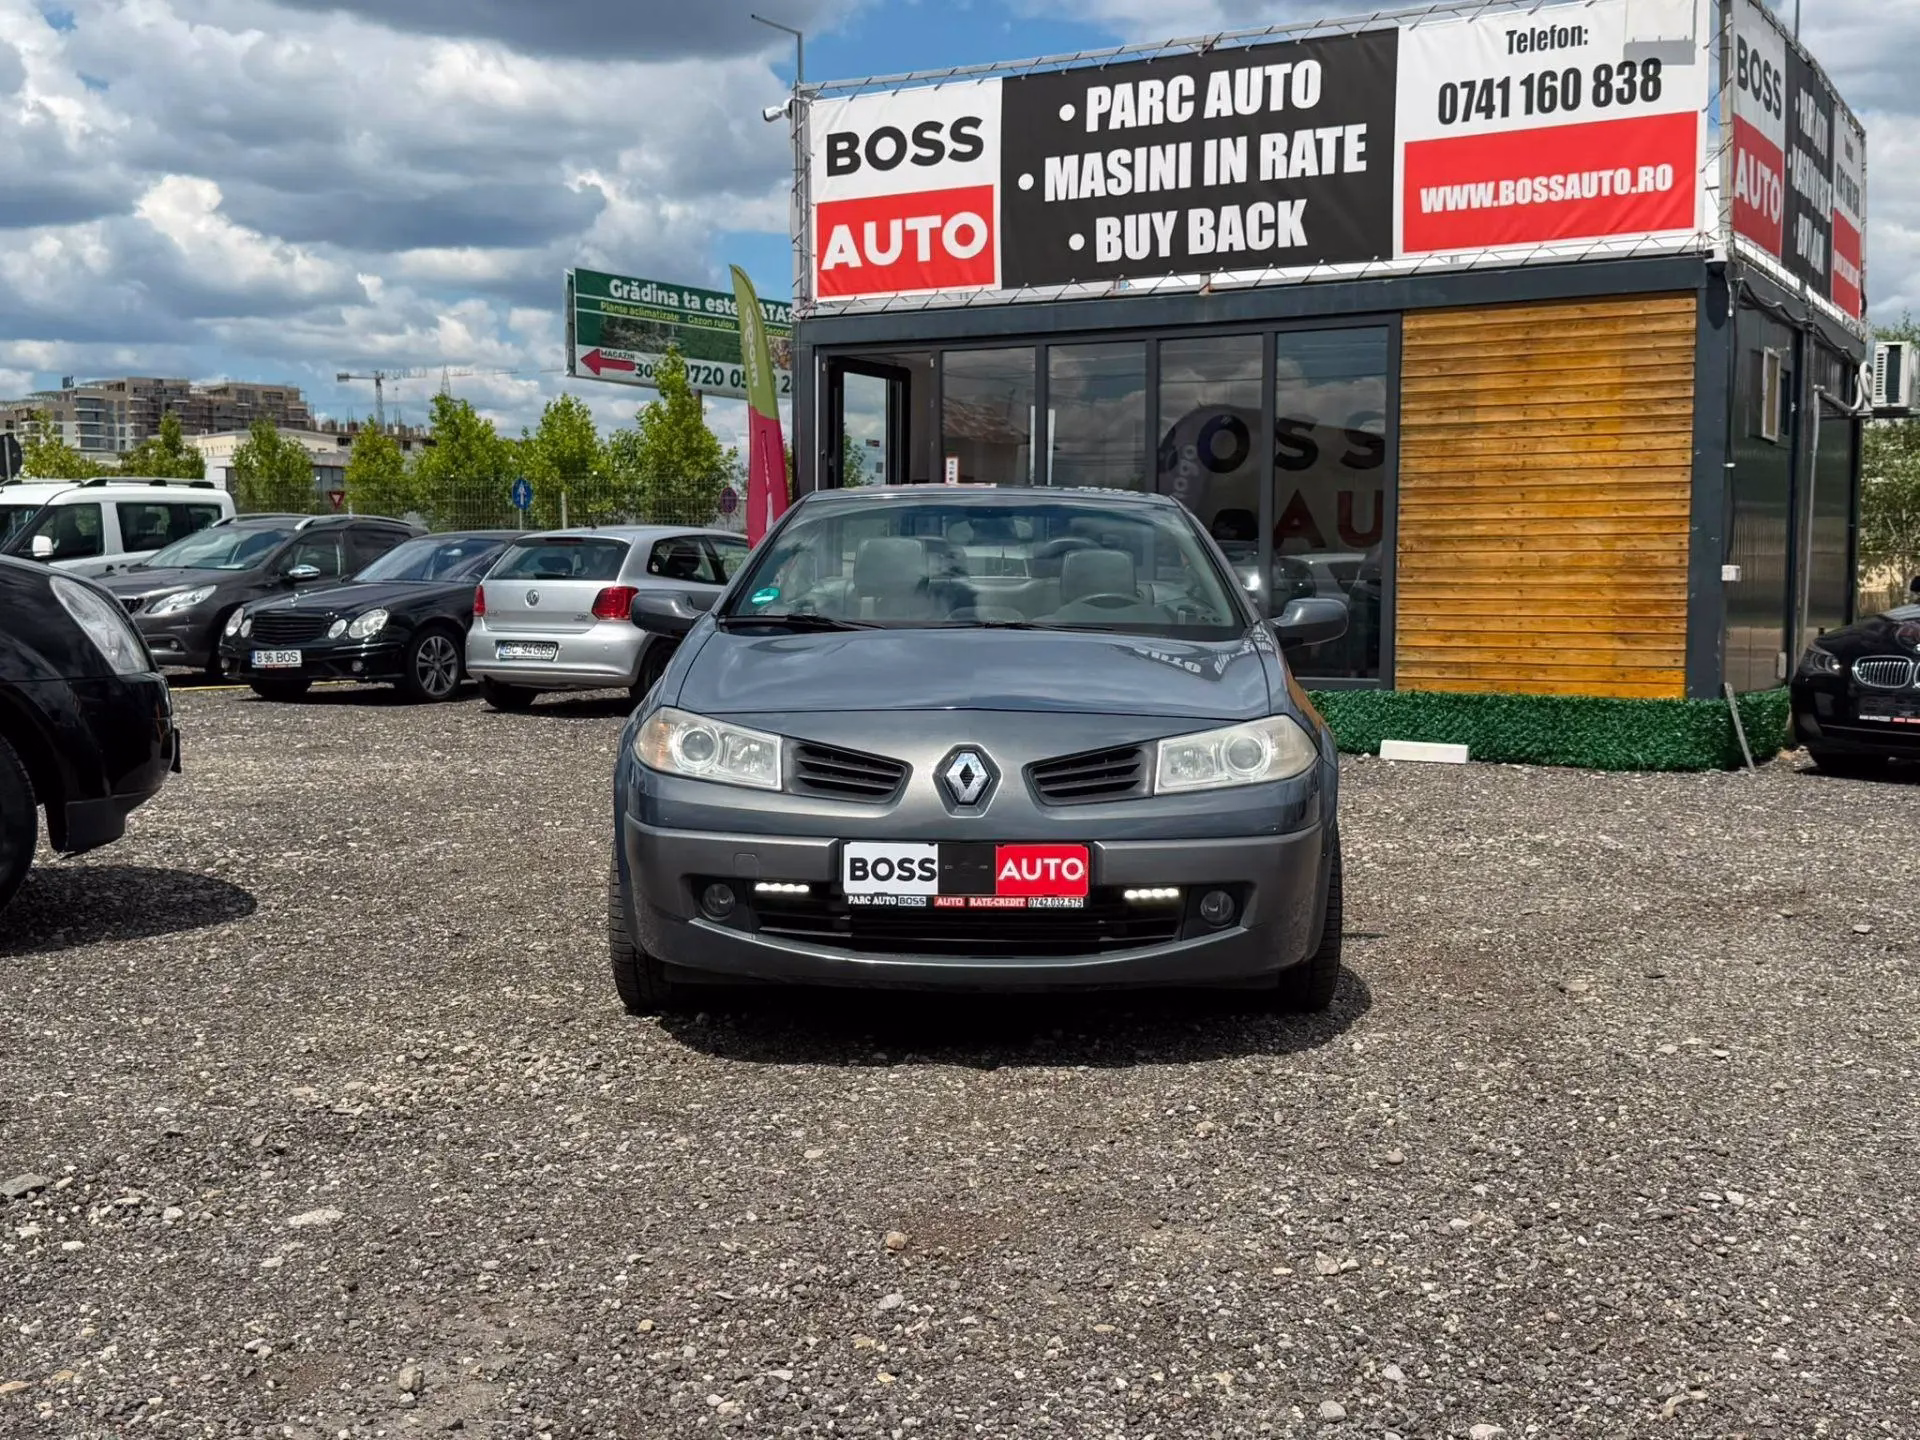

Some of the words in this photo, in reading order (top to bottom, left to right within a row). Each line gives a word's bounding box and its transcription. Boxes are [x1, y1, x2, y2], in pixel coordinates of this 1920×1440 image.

[1506, 24, 1588, 55] Telefon:
[1085, 75, 1196, 132] PARC
[1203, 60, 1322, 121] AUTO
[1438, 76, 1511, 125] 0741
[1519, 67, 1582, 115] 160
[1592, 57, 1662, 108] 838
[1737, 34, 1782, 121] BOSS
[826, 116, 984, 177] BOSS
[1044, 143, 1193, 202] MASINI
[1204, 136, 1251, 186] IN
[1258, 123, 1367, 182] RATE
[1420, 163, 1673, 214] WWW.BOSSAUTO.RO
[1734, 147, 1781, 225] AUTO
[821, 212, 988, 270] AUTO
[1095, 210, 1179, 263] BUY
[1187, 199, 1308, 254] BACK
[609, 278, 679, 307] Grădina
[683, 291, 700, 310] ta
[705, 297, 738, 316] este
[600, 349, 635, 360] MAGAZIN
[276, 651, 299, 663] BOS
[850, 857, 937, 882] BOSS
[998, 857, 1085, 881] AUTO
[848, 895, 871, 905] PARC
[872, 895, 897, 905] AUTO
[899, 896, 926, 906] BOSS
[936, 897, 965, 906] AUTO
